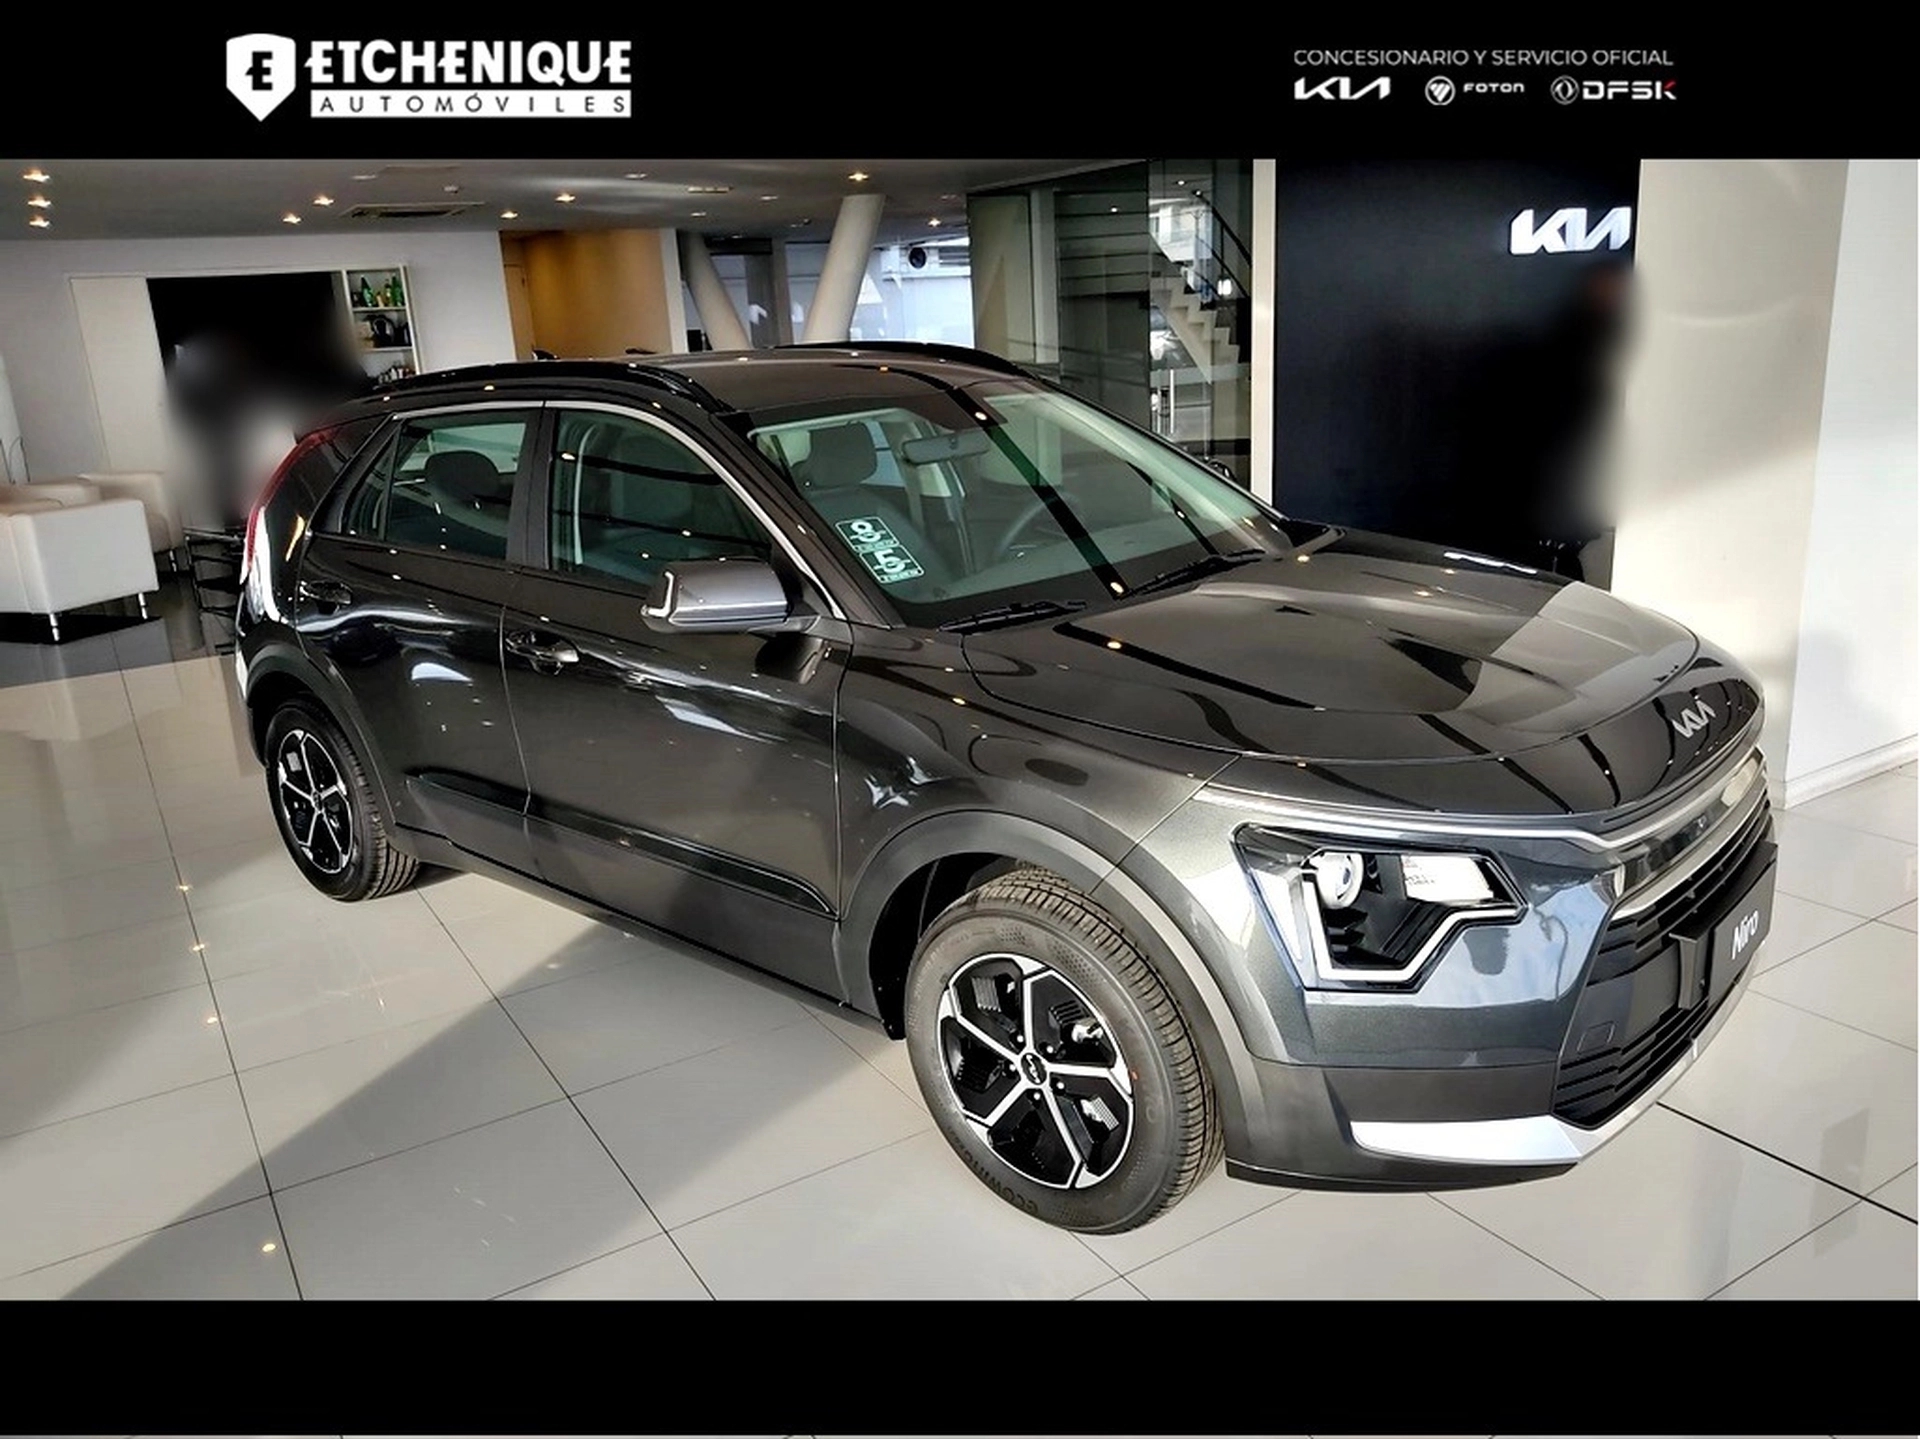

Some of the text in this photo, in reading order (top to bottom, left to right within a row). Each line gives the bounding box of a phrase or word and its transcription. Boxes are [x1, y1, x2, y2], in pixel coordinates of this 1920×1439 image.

[1510, 206, 1631, 254] KIA
[1671, 700, 1716, 738] KIA
[1731, 910, 1758, 960] Niro
